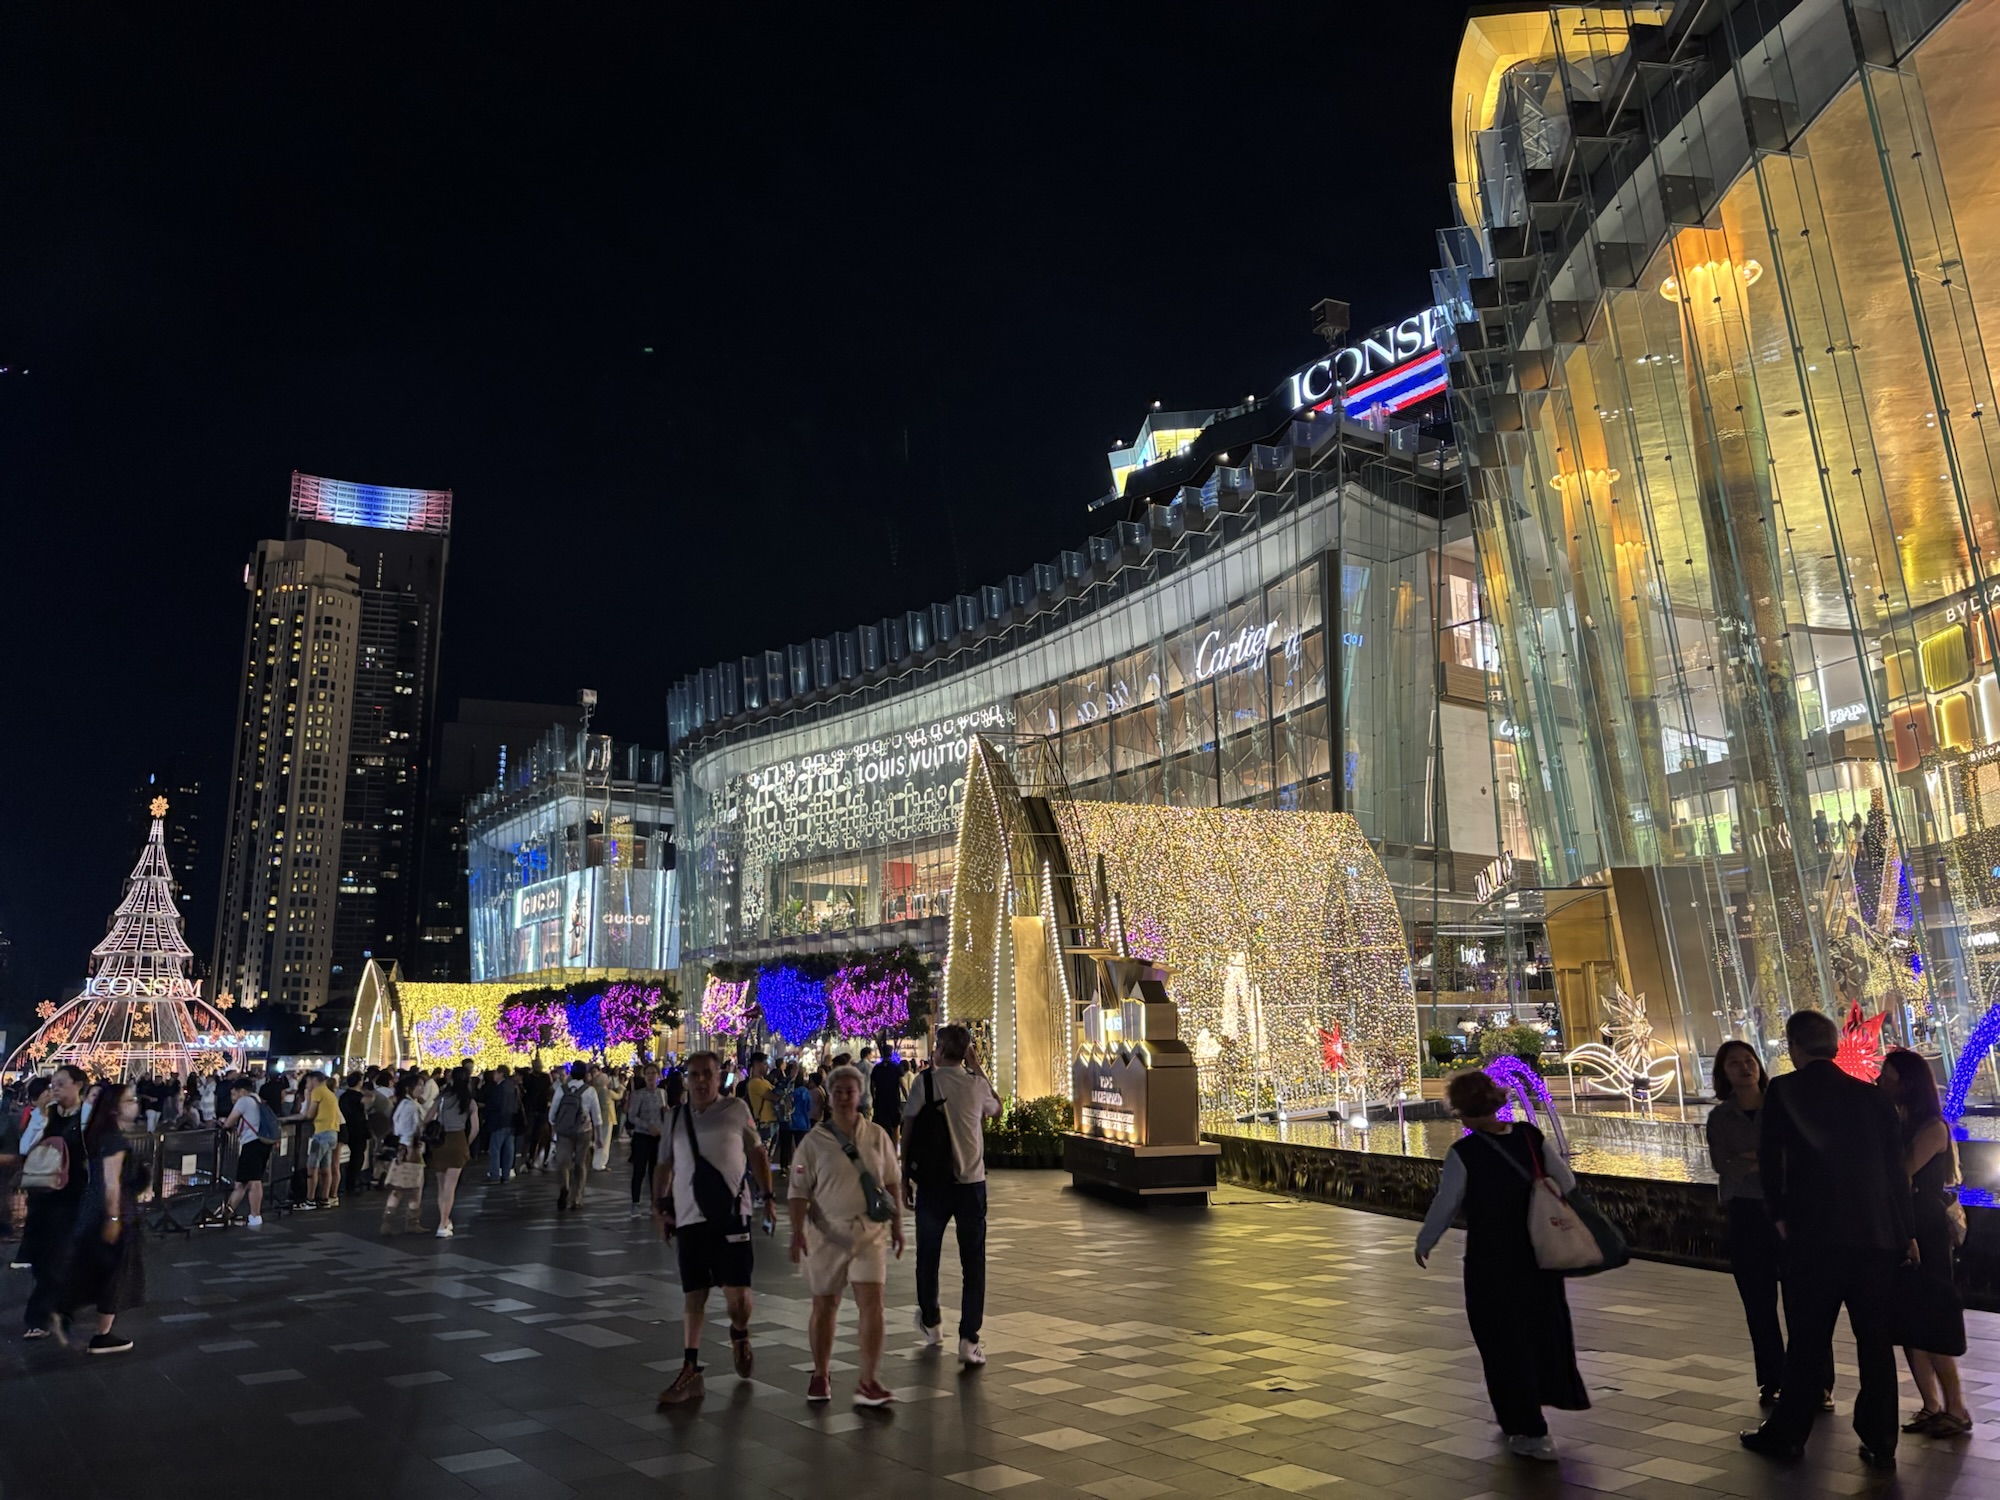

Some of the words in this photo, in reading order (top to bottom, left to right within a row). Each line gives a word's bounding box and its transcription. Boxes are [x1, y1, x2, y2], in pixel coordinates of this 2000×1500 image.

[1196, 620, 1279, 679] Cartier
[858, 755, 905, 785] LOUIS
[522, 888, 560, 916] GUCCI
[602, 912, 651, 926] GUCCI
[85, 976, 203, 998] ICONSIAM
